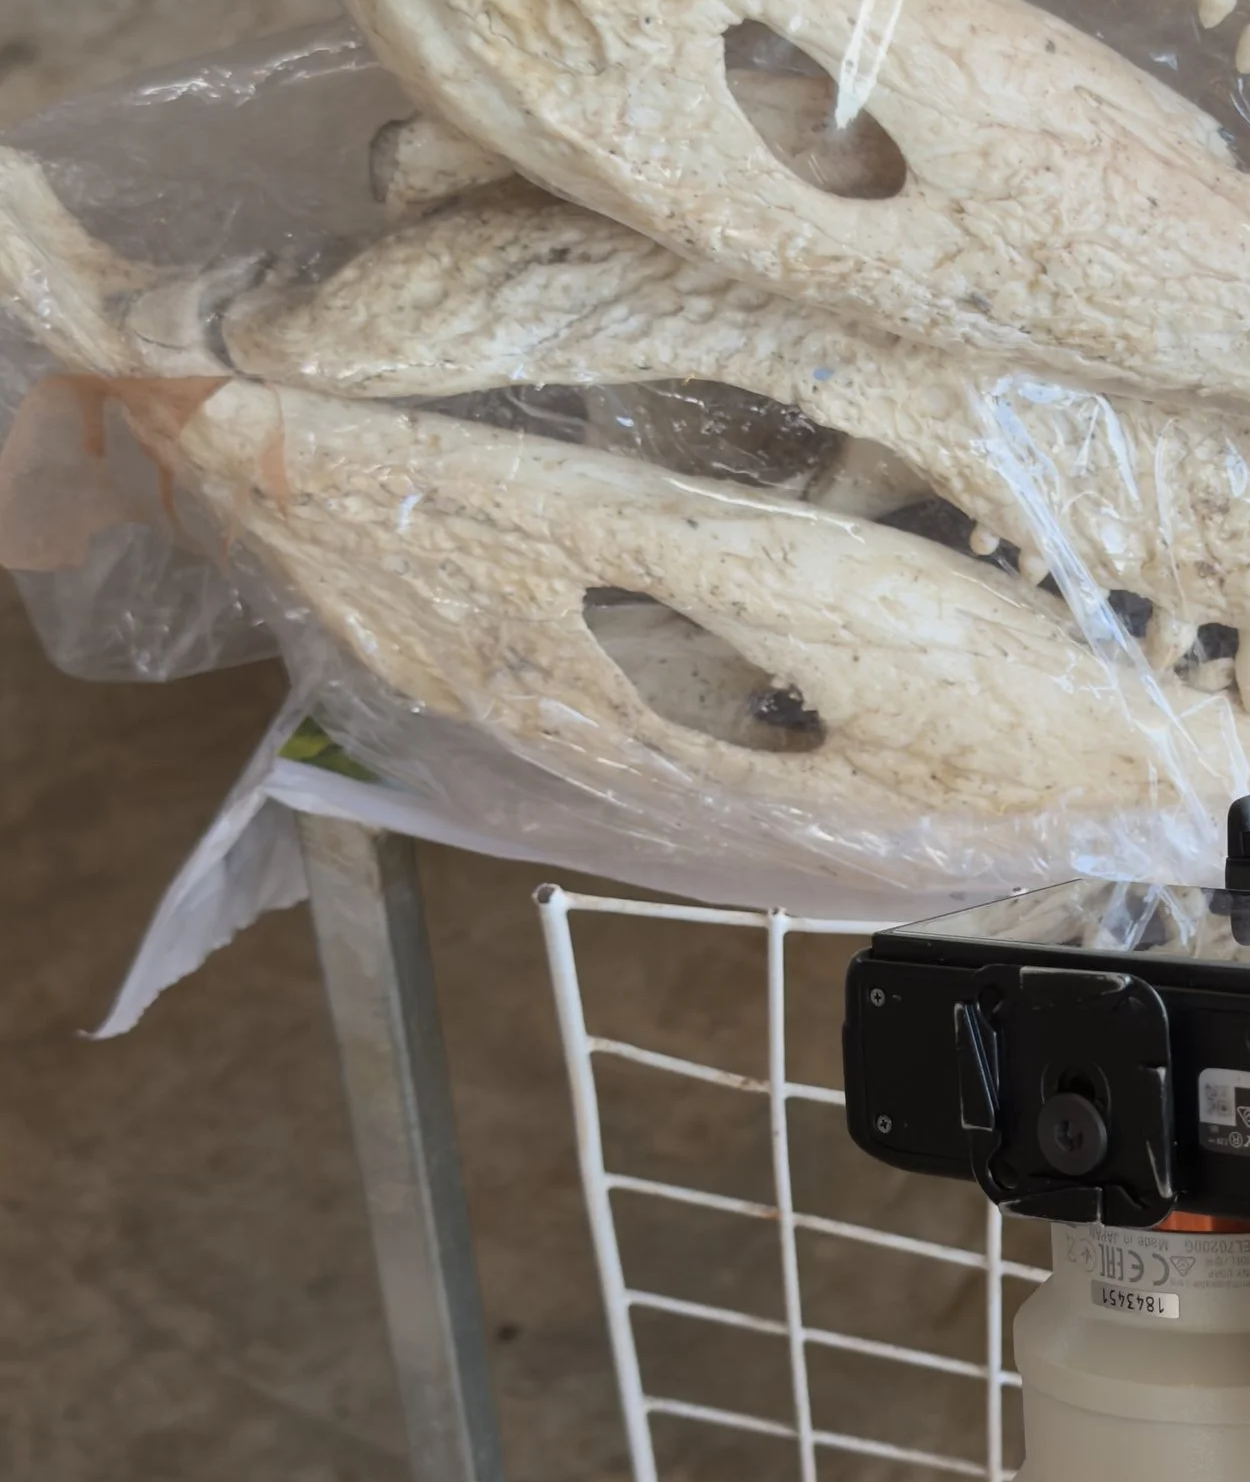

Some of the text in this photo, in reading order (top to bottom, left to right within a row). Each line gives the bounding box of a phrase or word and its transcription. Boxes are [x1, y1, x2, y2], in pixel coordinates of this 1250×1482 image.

[1123, 1235, 1133, 1244] in
[1138, 1236, 1168, 1251] Made
[1102, 1287, 1164, 1314] 1843451
